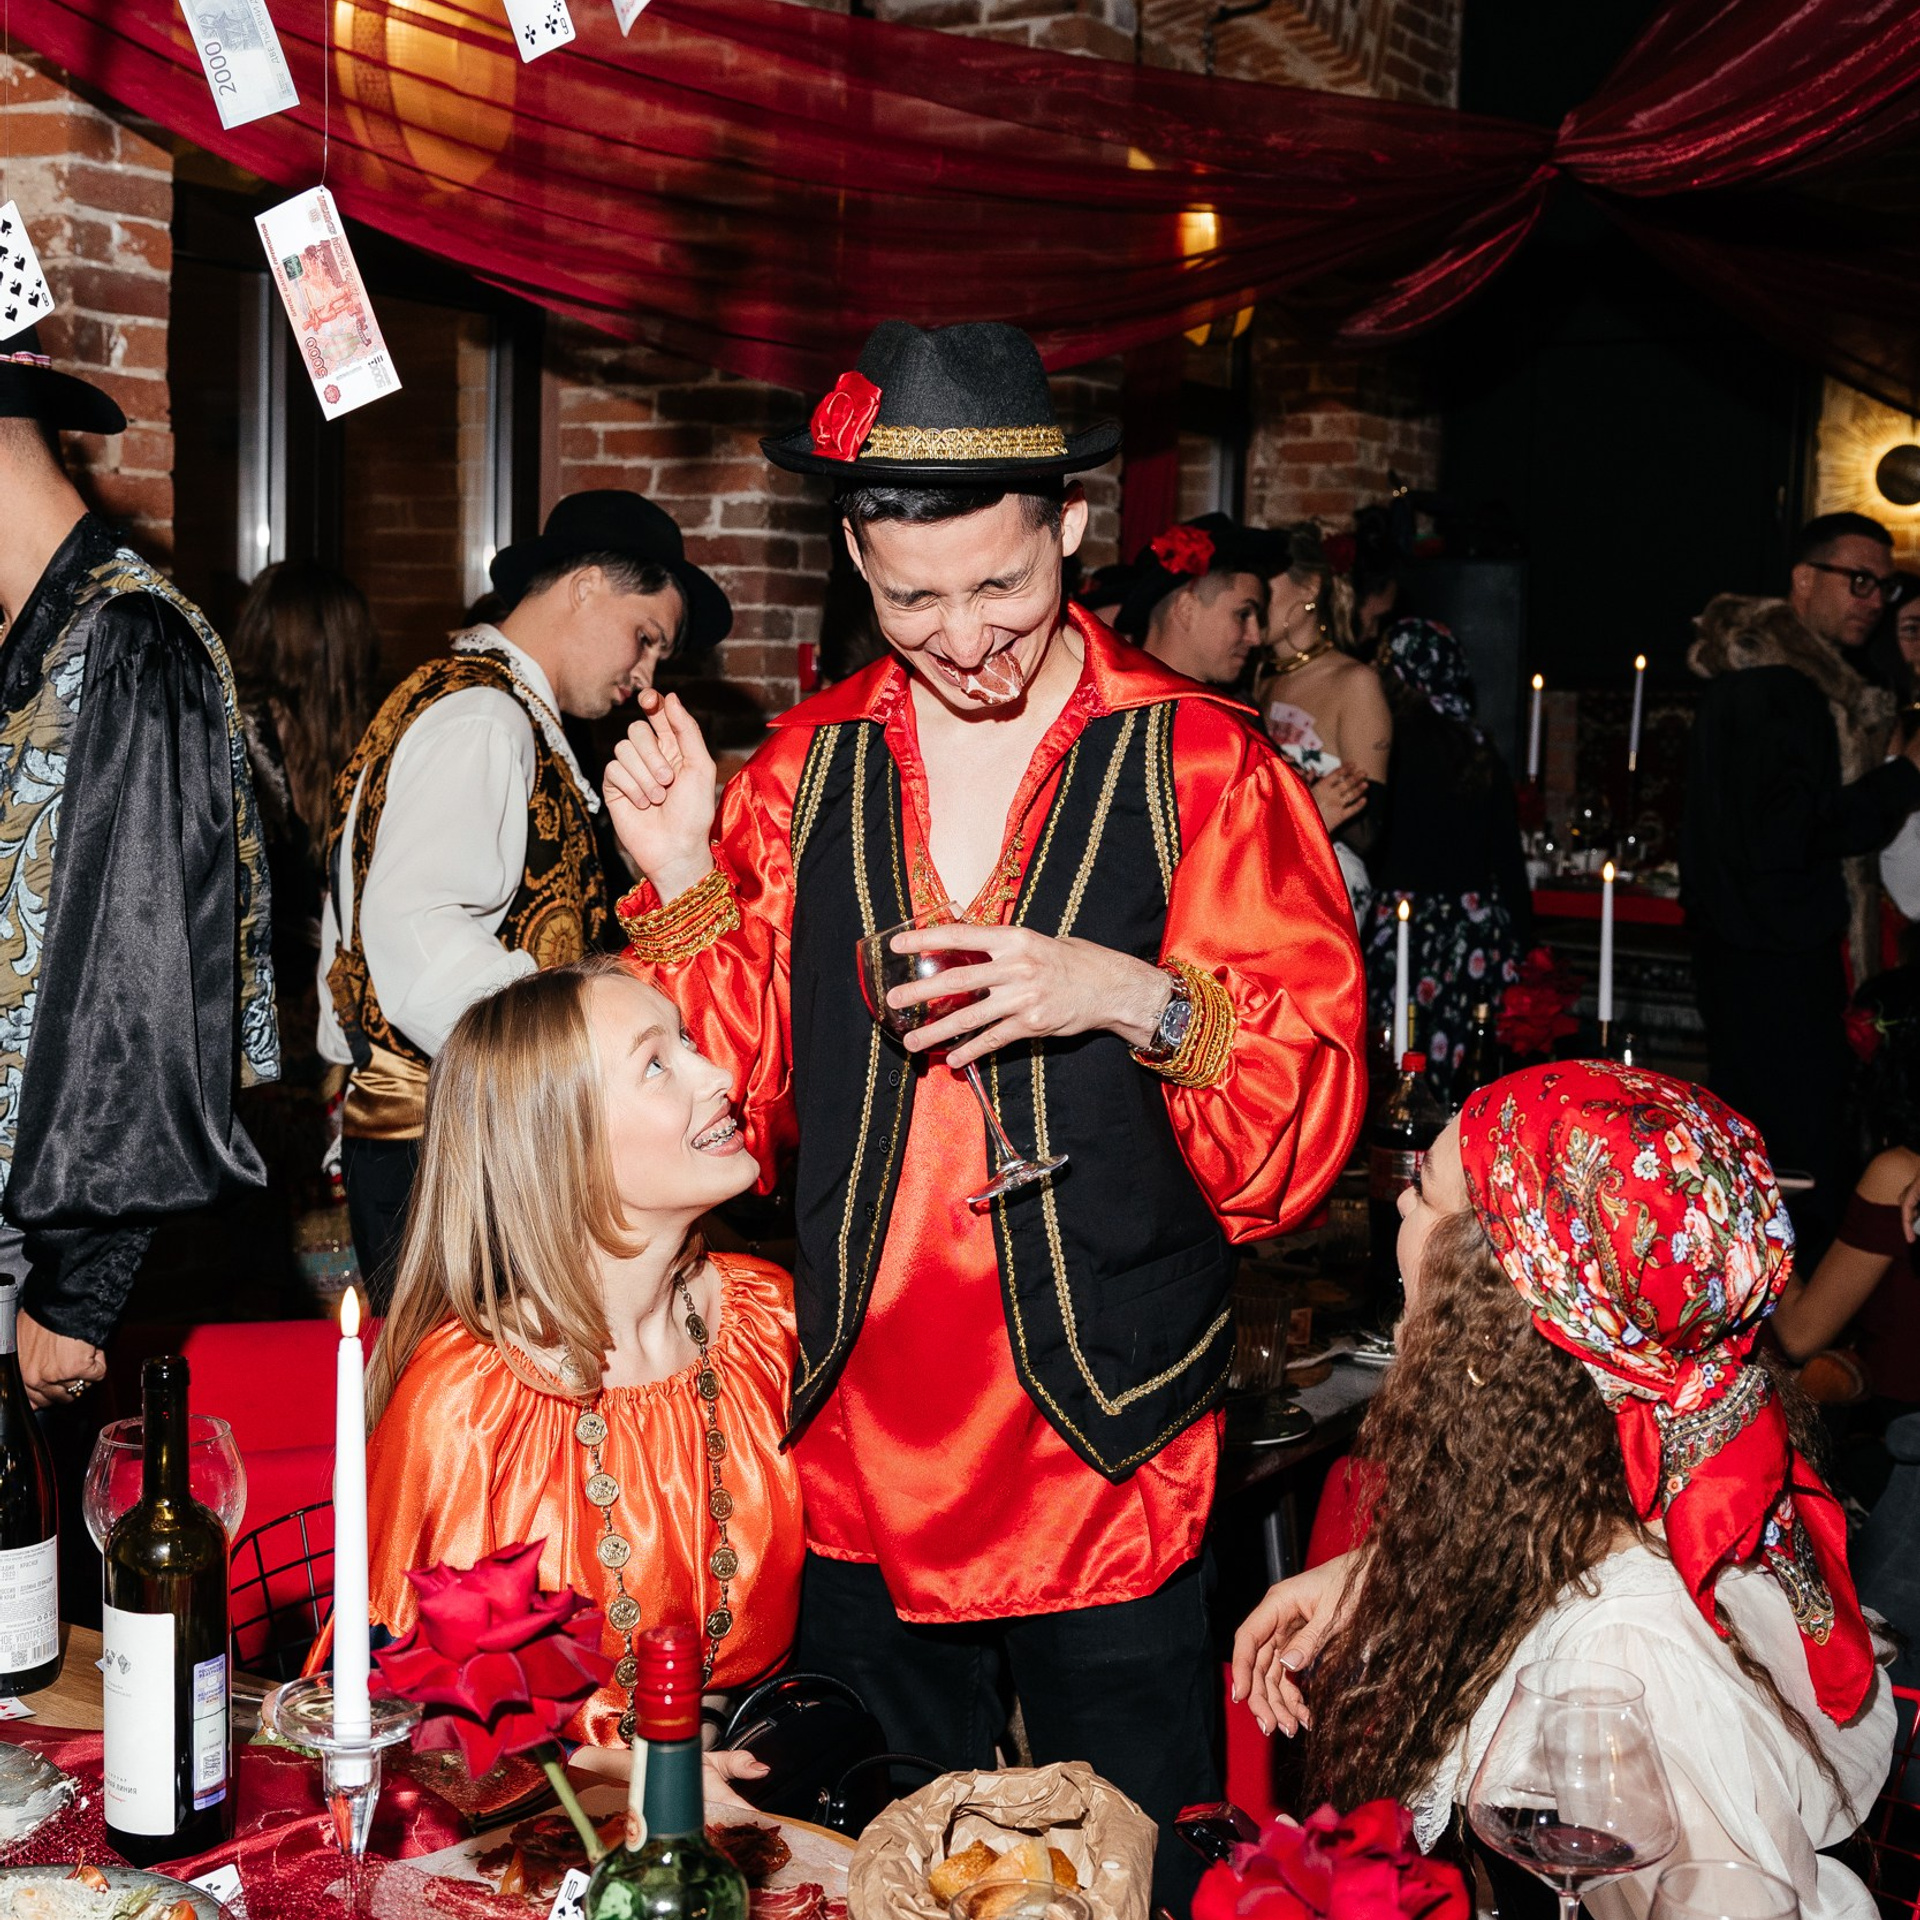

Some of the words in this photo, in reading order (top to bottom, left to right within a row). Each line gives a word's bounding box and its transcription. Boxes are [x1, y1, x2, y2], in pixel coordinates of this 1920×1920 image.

[252, 7, 272, 44] ТЫСЯЧИ
[204, 41, 237, 96] 2000
[267, 46, 280, 64] ДВЕ
[260, 223, 279, 265] ПРИКОЛОВ
[305, 336, 329, 379] 5000
[116, 1783, 138, 1795] ЛИНИЯ
[565, 1878, 578, 1901] 10
